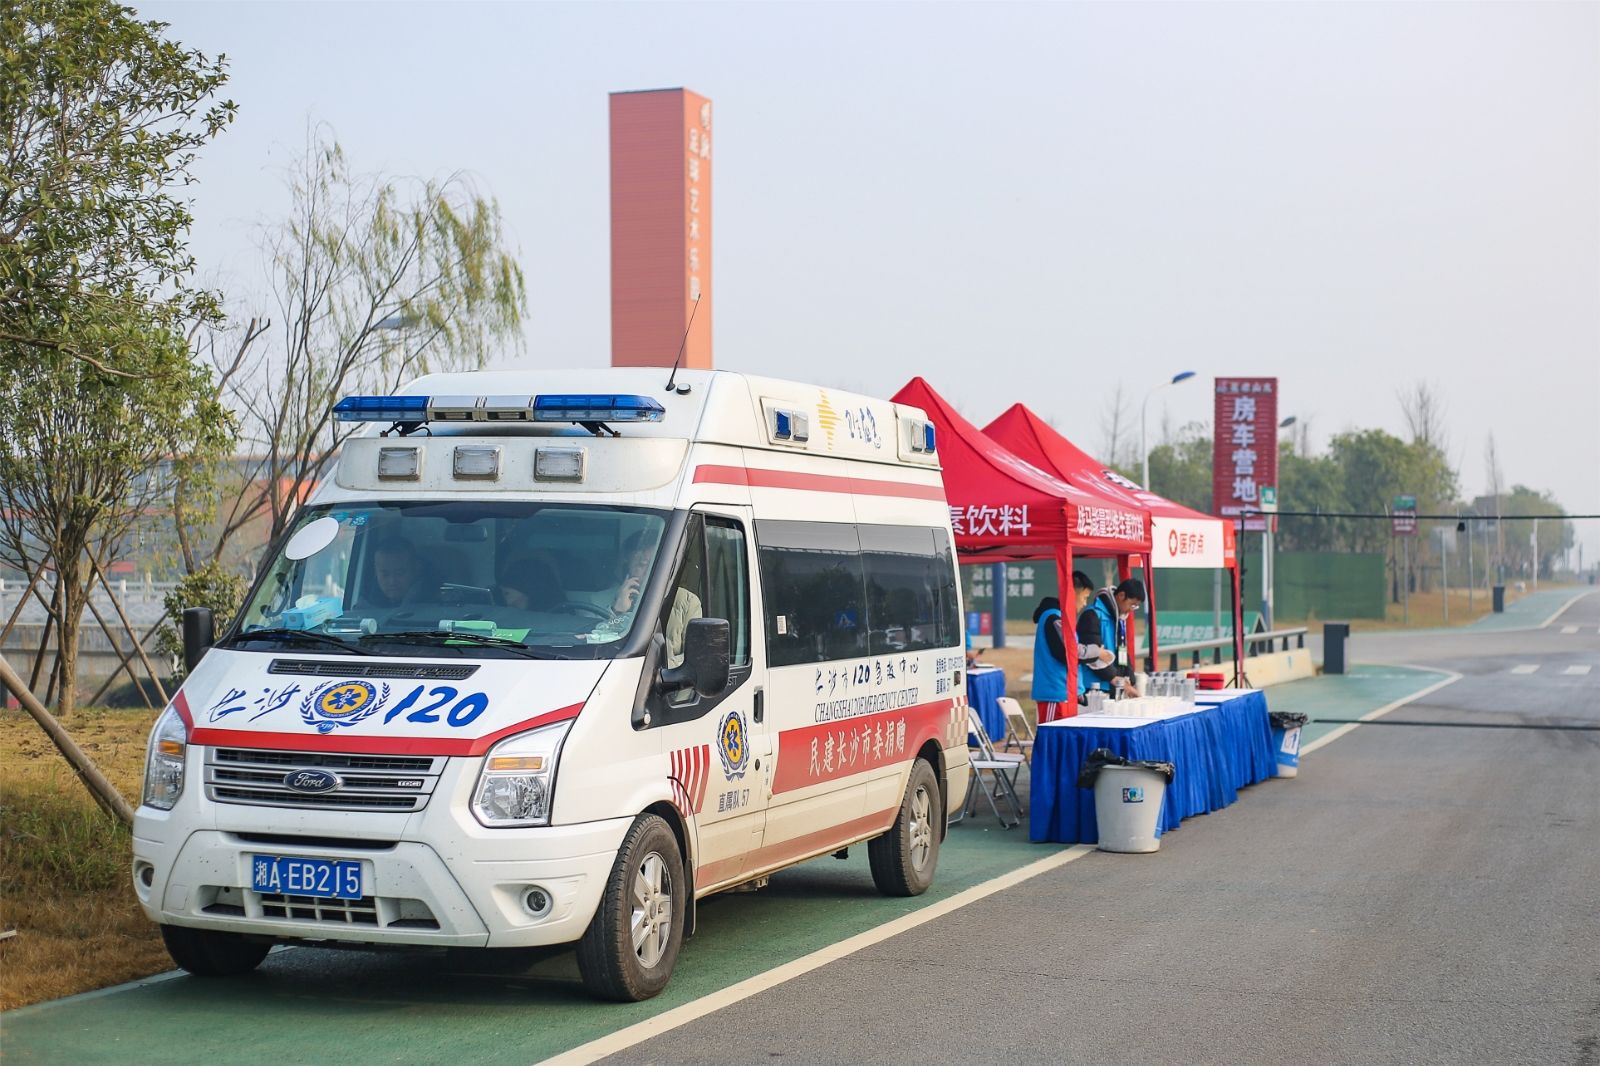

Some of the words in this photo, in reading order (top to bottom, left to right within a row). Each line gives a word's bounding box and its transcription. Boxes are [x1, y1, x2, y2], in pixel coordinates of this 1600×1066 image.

[1232, 396, 1257, 502] 房车营地
[1179, 533, 1205, 554] 医疗点
[383, 684, 489, 727] 120
[808, 718, 907, 777] 民建长沙市委捐赠
[293, 772, 329, 789] Ford
